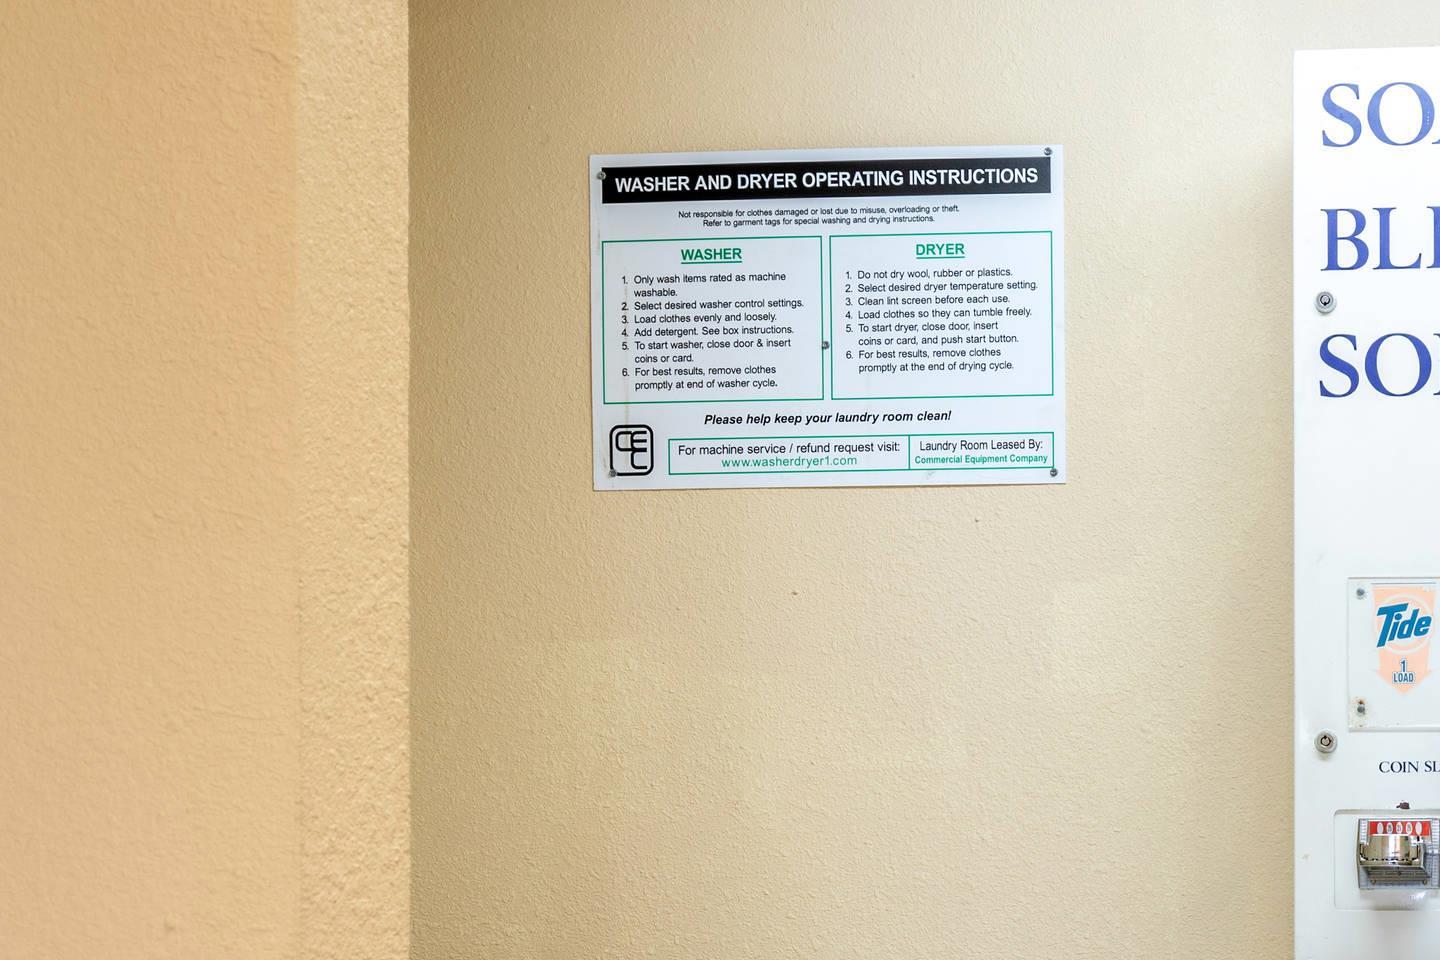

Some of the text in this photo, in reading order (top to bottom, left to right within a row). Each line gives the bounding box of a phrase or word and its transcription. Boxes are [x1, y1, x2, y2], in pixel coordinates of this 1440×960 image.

[614, 167, 1038, 192] WASHER AND DRYER OPERATING INSTRUCTIONS
[678, 210, 691, 218] Not
[692, 209, 733, 218] responsible
[735, 209, 745, 217] for
[774, 208, 808, 217] damaged
[819, 207, 833, 215] lost
[888, 205, 930, 214] overloading
[941, 204, 959, 212] theft.
[680, 247, 742, 260] WASHER
[915, 243, 965, 255] DRYER
[633, 274, 654, 286] Only
[656, 274, 680, 283] wash
[682, 273, 707, 283] items
[709, 272, 732, 282] rated
[734, 274, 746, 282] as
[748, 271, 786, 281] machine
[857, 269, 871, 279] Do
[873, 270, 888, 279] not
[889, 269, 905, 280] dry
[906, 268, 930, 279] wool,
[933, 268, 963, 278] rubber
[965, 269, 975, 277] or
[977, 267, 1013, 279] plastics.
[633, 287, 677, 297] washable.
[857, 283, 886, 292] Select
[887, 282, 921, 292] desired
[923, 281, 947, 293] dryer
[949, 281, 1004, 292] temperature
[1006, 279, 1038, 291] setting.
[633, 301, 662, 310] Select
[664, 299, 697, 310] desired
[698, 299, 732, 309] washer
[734, 298, 765, 308] control
[767, 298, 804, 309] settings.
[857, 296, 884, 306] Clean
[886, 296, 899, 305] lint
[901, 297, 932, 305] screen
[934, 294, 964, 304] before
[966, 294, 989, 303] each
[991, 295, 1010, 303] use.
[634, 313, 656, 324] Load
[658, 313, 691, 323] clothes
[693, 312, 722, 324] evenly
[724, 312, 741, 322] and
[744, 311, 777, 322] loosely.
[703, 409, 952, 426] Please help keep your laundry room clean!
[678, 441, 900, 455] For machine service / refund request visit:
[919, 438, 1042, 453] Laundry Room Leased By:
[721, 455, 857, 468] www.washerdryer1.com
[914, 453, 1048, 464] Commercial Equipment Company
[1376, 603, 1432, 648] Tide
[1400, 660, 1407, 673] 1
[1393, 672, 1414, 683] LOAD
[1379, 761, 1419, 773] COIN
